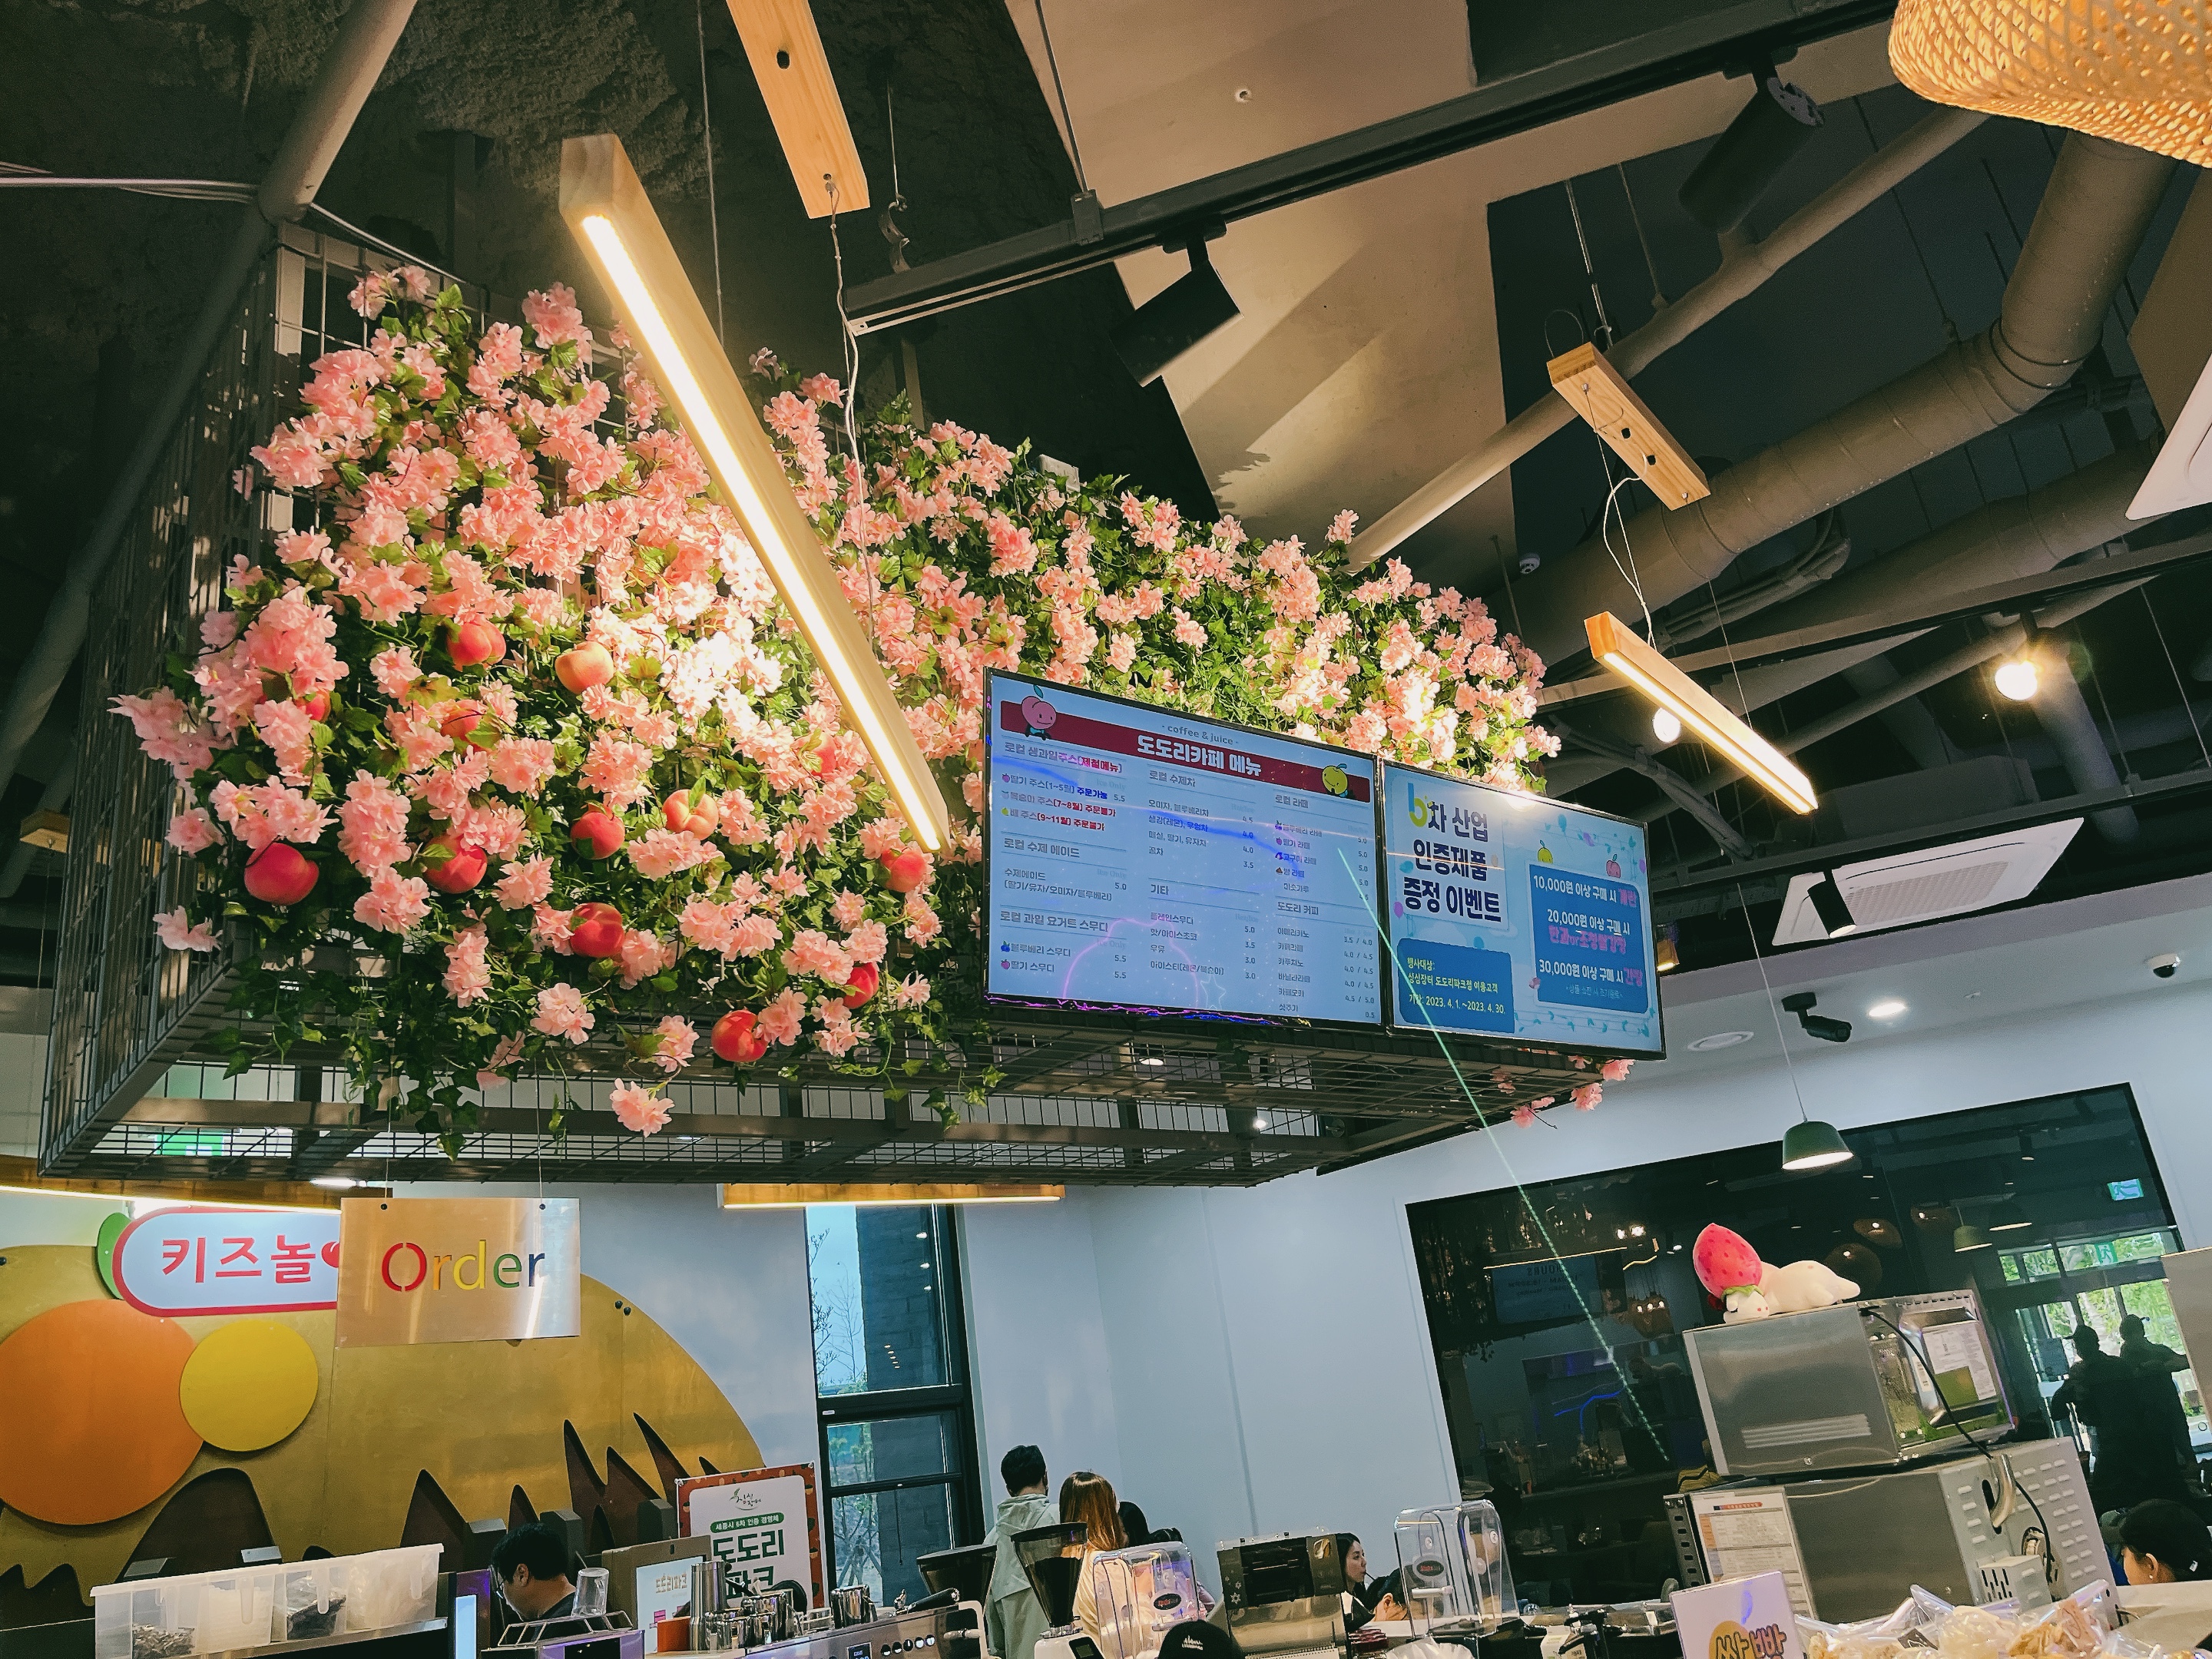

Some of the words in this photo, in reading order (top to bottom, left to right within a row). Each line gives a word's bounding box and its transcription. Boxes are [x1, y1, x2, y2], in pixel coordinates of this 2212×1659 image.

[1167, 724, 1200, 738] coffee
[1202, 731, 1209, 740] &
[1210, 733, 1233, 746] juice
[1005, 742, 1025, 754] 로컬
[1137, 734, 1224, 770] 도도리카페
[1229, 753, 1263, 777] 메뉴
[1149, 770, 1167, 782] 로컬
[1010, 775, 1027, 785] 딸기
[1029, 778, 1075, 794] 주스(1~5월)
[1077, 786, 1108, 800] 주문가능
[1114, 794, 1125, 803] 5.5
[1010, 791, 1035, 803] 복숭아
[1085, 804, 1116, 817] 주문불가
[1275, 794, 1291, 806] 로컬
[1010, 808, 1018, 816] 배
[1074, 819, 1105, 831] 주문불가
[1452, 806, 1488, 843] 산업
[1242, 830, 1253, 839] 4.0
[1004, 838, 1025, 850] 로컬
[1027, 841, 1048, 854] 수제
[1050, 845, 1080, 858] 에이드
[1243, 846, 1254, 854] 4.0
[1243, 860, 1254, 869] 3.5
[1413, 839, 1487, 882] 인증제품
[1005, 868, 1046, 881] 수제에이드
[1114, 882, 1127, 890] 5.0
[1151, 884, 1169, 896] 기타
[1533, 875, 1573, 894] 10,000원
[1575, 882, 1591, 898] 이상
[1593, 886, 1608, 901] 구매
[1609, 889, 1617, 902] 시
[1277, 901, 1301, 912] 도도리
[1303, 905, 1319, 916] 커피
[1403, 877, 1440, 913] 증정
[1446, 886, 1501, 922] 이벤트
[1000, 910, 1021, 923] 로컬
[1024, 913, 1044, 925] 과일
[1047, 916, 1077, 929] 요거트
[1079, 919, 1108, 932] 스무디
[1547, 909, 1588, 928] 20,000원
[1589, 916, 1604, 931] 이상
[1606, 919, 1621, 933] 구매
[1623, 922, 1630, 935] 시
[1011, 943, 1045, 955] 블루베리
[1046, 947, 1071, 957] 스무디
[1151, 944, 1165, 953] 우유
[1011, 962, 1028, 971] 딸기
[1030, 963, 1055, 973] 스무디
[1114, 971, 1127, 979] 5.5
[1539, 959, 1581, 978] 30,000원
[1582, 965, 1597, 980] 이상
[1599, 967, 1614, 982] 구매
[1616, 970, 1624, 983] 시
[381, 1239, 546, 1293] Order
[713, 1529, 785, 1564] 도도리
